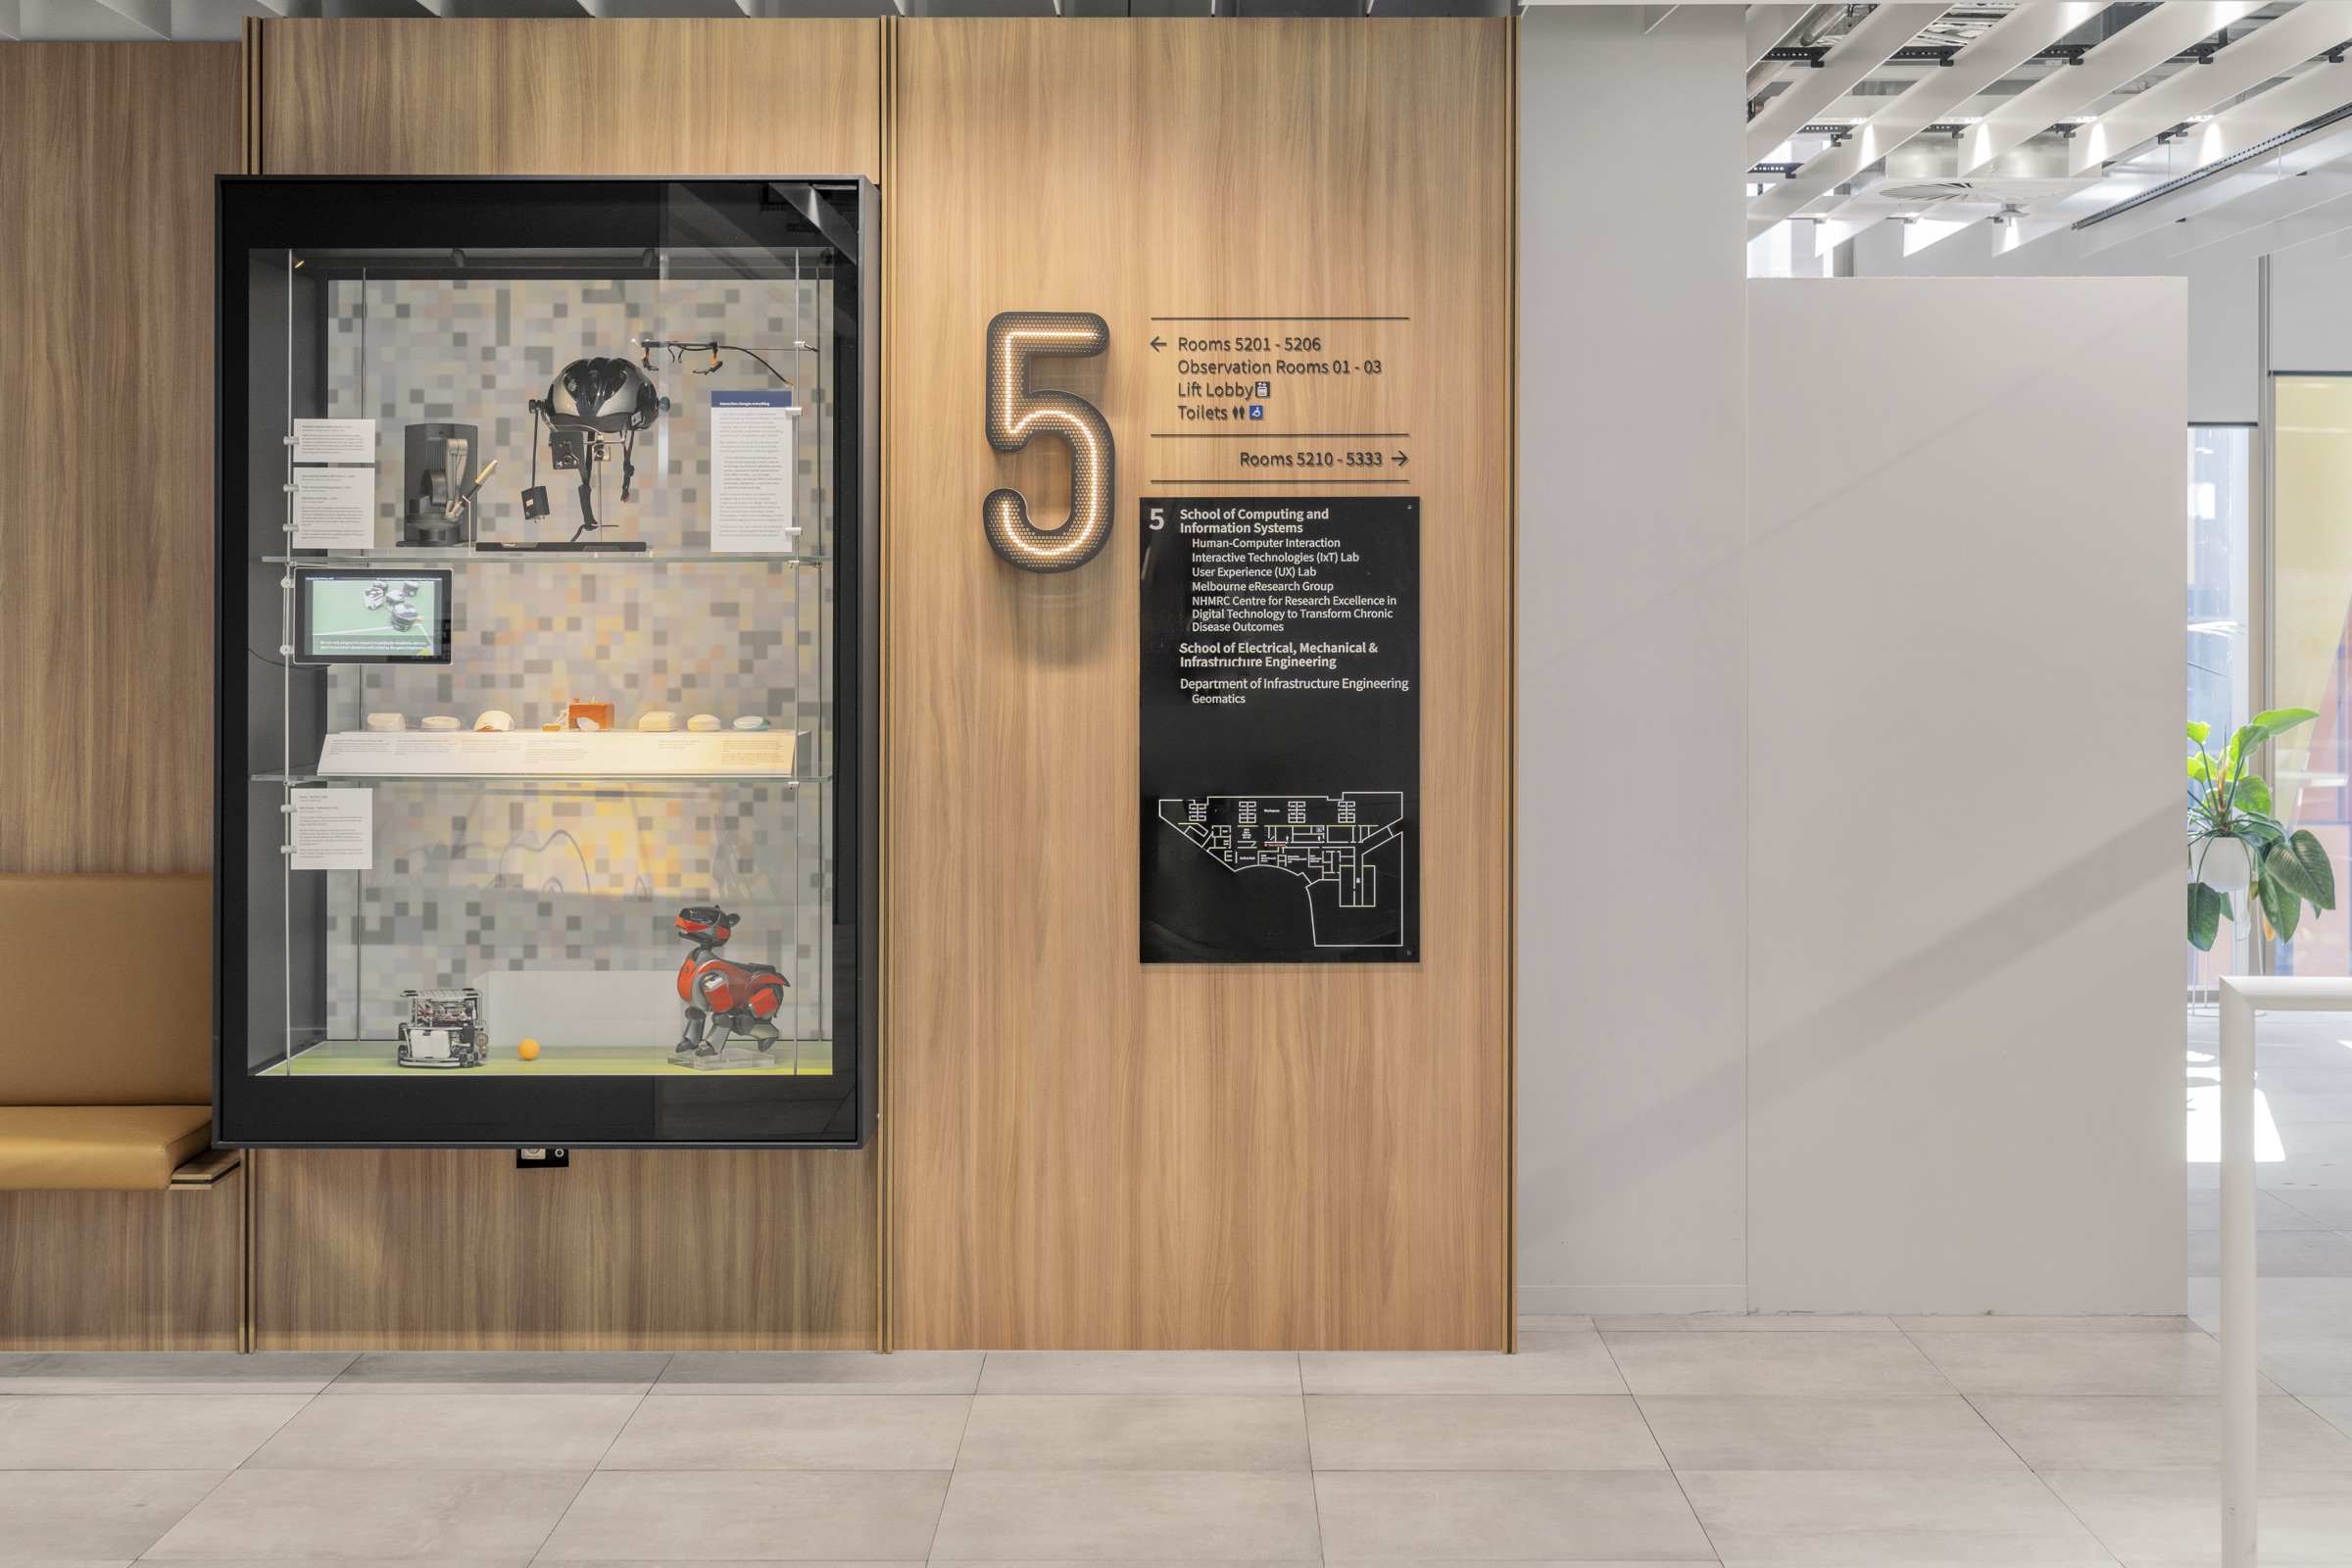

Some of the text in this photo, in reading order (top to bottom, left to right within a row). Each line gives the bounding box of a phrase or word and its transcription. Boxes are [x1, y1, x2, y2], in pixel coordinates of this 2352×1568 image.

[1179, 337, 1231, 352] Rooms
[1235, 337, 1270, 351] 5201
[1285, 337, 1321, 352] 5206
[1178, 360, 1271, 374] Observation
[1277, 361, 1328, 373] Rooms
[1333, 361, 1349, 373] 01
[1364, 361, 1381, 373] 03
[1179, 381, 1253, 401] Lift Lobby
[1178, 405, 1228, 420] Toilets
[983, 312, 1115, 573] 5
[1241, 453, 1293, 466] Rooms
[1297, 453, 1333, 466] 5210
[1347, 453, 1382, 466] 5333
[1150, 509, 1164, 530] 5
[1181, 509, 1328, 521] School of Computing and
[1181, 522, 1302, 535] Information Systems
[1193, 538, 1340, 550] Human-Computer Interaction
[1193, 552, 1359, 564] Interactive Technologies (IxT) Lab
[1193, 566, 1316, 578] User Experience (UX) Lab
[1193, 581, 1333, 593] Melbourne eResearch Group
[1193, 596, 1230, 606] NHMRC
[1268, 596, 1283, 605] for
[1286, 596, 1330, 605] Research
[1334, 596, 1385, 605] Excellence
[1388, 596, 1396, 605] in
[1193, 609, 1393, 621] Digital Technology to Transform Chronic
[1193, 622, 1284, 631] Disease Outcomes
[1179, 642, 1378, 655] School of Electrical, Mechanical &
[1266, 656, 1336, 669] Engineering
[1180, 678, 1408, 692] Department of Infrastructure Engineering
[1193, 694, 1246, 703] Geomatics
